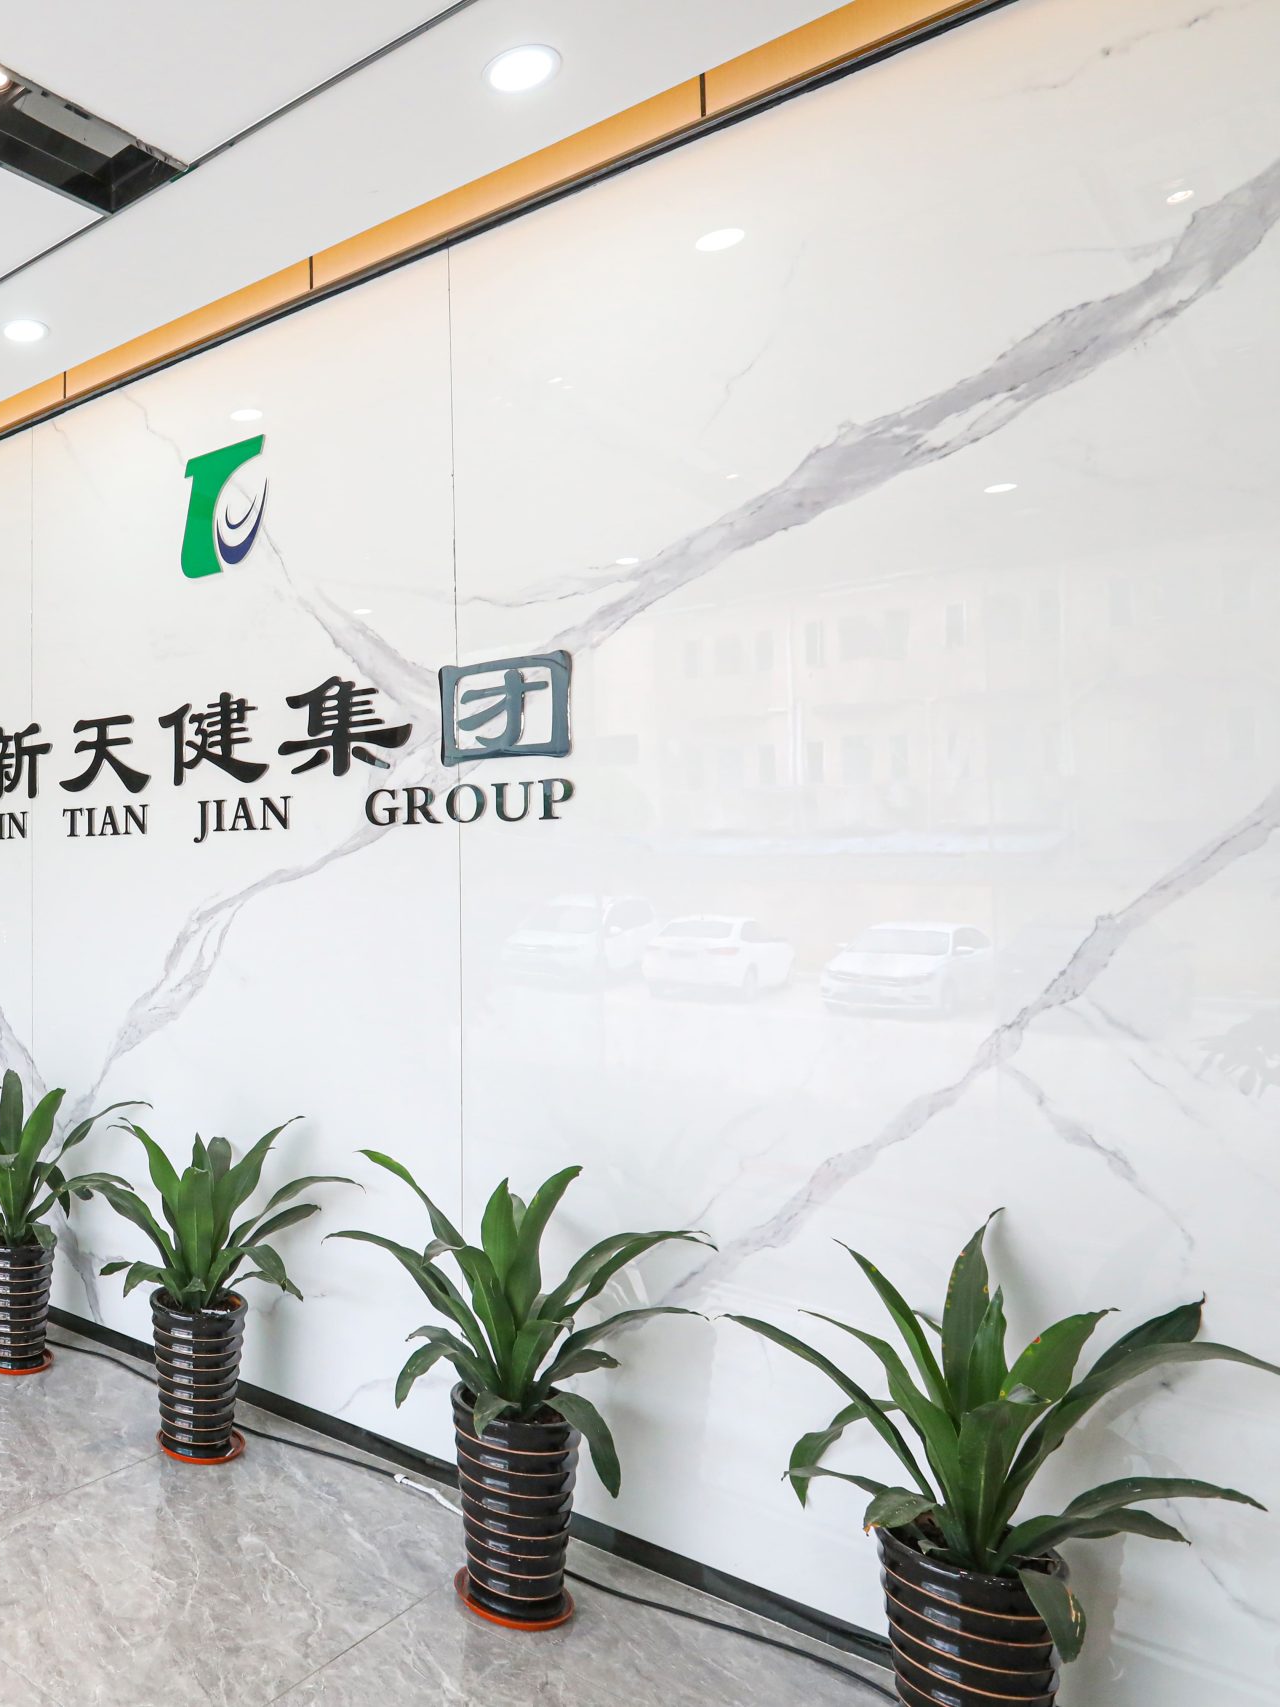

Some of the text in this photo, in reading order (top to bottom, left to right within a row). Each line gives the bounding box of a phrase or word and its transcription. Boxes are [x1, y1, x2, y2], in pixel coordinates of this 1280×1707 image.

[62, 804, 150, 838] TIAN
[193, 795, 293, 844] JIAN
[364, 778, 575, 828] GROUP
